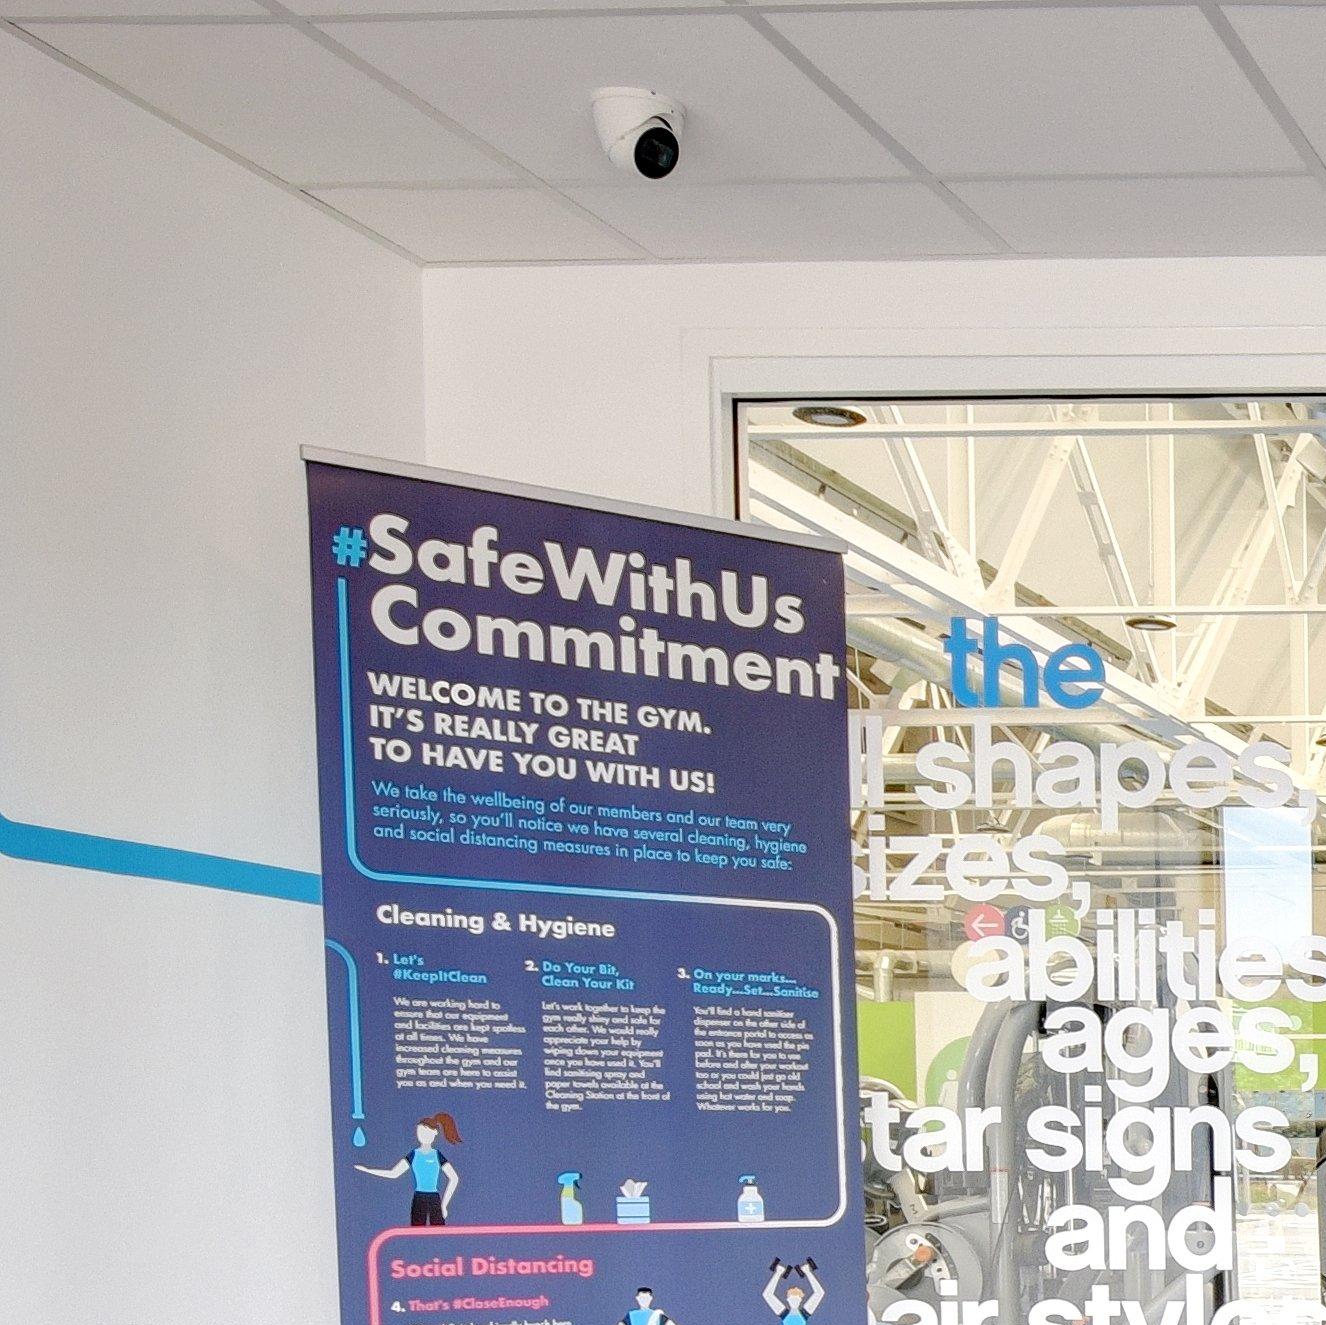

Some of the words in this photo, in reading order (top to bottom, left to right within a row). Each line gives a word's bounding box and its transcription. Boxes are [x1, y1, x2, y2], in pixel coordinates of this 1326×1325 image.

[332, 513, 804, 634] #SafeWithUs
[370, 583, 839, 700] Commitment
[943, 616, 1106, 709] the
[367, 671, 521, 712] WELCOME
[529, 692, 569, 718] TO
[577, 697, 627, 725] THE
[637, 705, 711, 734] GYM.
[370, 704, 424, 731] IT'S
[434, 712, 539, 744] REALLY
[547, 725, 638, 755] GREAT
[369, 737, 411, 764] TO
[423, 744, 503, 774] HAVE
[512, 753, 577, 781] YOU
[586, 761, 659, 788] WITH
[670, 769, 716, 794] US!
[915, 716, 1318, 834] shapes,
[371, 780, 400, 798] We
[405, 783, 438, 802] take
[443, 786, 466, 804] the
[470, 791, 545, 815] wellbeing
[549, 796, 566, 813] of
[569, 803, 593, 816] our
[598, 804, 662, 822] members
[666, 809, 694, 825] and
[698, 815, 721, 827] our
[725, 815, 758, 831] team
[761, 820, 791, 836] very
[372, 804, 444, 825] seriously,
[449, 811, 467, 824] so
[471, 812, 513, 829] you'll
[518, 816, 563, 834] notice
[567, 822, 589, 835] we
[594, 821, 629, 838] have
[633, 828, 684, 843] several
[687, 830, 750, 851] cleaning,
[754, 834, 807, 855] hygiene
[373, 823, 405, 839] and
[410, 827, 454, 843] social
[459, 829, 538, 854] distancing
[543, 839, 610, 857] measures
[615, 844, 629, 858] in
[633, 844, 673, 862] place
[676, 850, 691, 862] to
[694, 849, 729, 868] keep
[731, 857, 757, 869] you
[376, 904, 484, 935] Cleaning
[491, 912, 512, 932] &
[518, 913, 615, 939] Hygiene
[376, 951, 389, 965] 1.
[393, 953, 424, 967] Let's
[393, 969, 488, 985] #KeepItClean
[524, 960, 539, 972] 2.
[542, 961, 562, 974] Do
[566, 963, 596, 975] Your
[542, 975, 580, 989] Clean
[582, 977, 611, 990] Your
[616, 977, 635, 990] Kit
[677, 967, 691, 979] 3.
[693, 968, 712, 981] On
[716, 970, 744, 985] your
[1042, 1004, 1319, 1102] ages,
[862, 1091, 1001, 1173] tar
[1026, 1086, 1292, 1201] signs
[1045, 1177, 1232, 1271] and
[391, 1256, 463, 1279] Social
[471, 1254, 594, 1279] Distancing
[391, 1300, 406, 1313] 4.
[408, 1299, 449, 1312] That's
